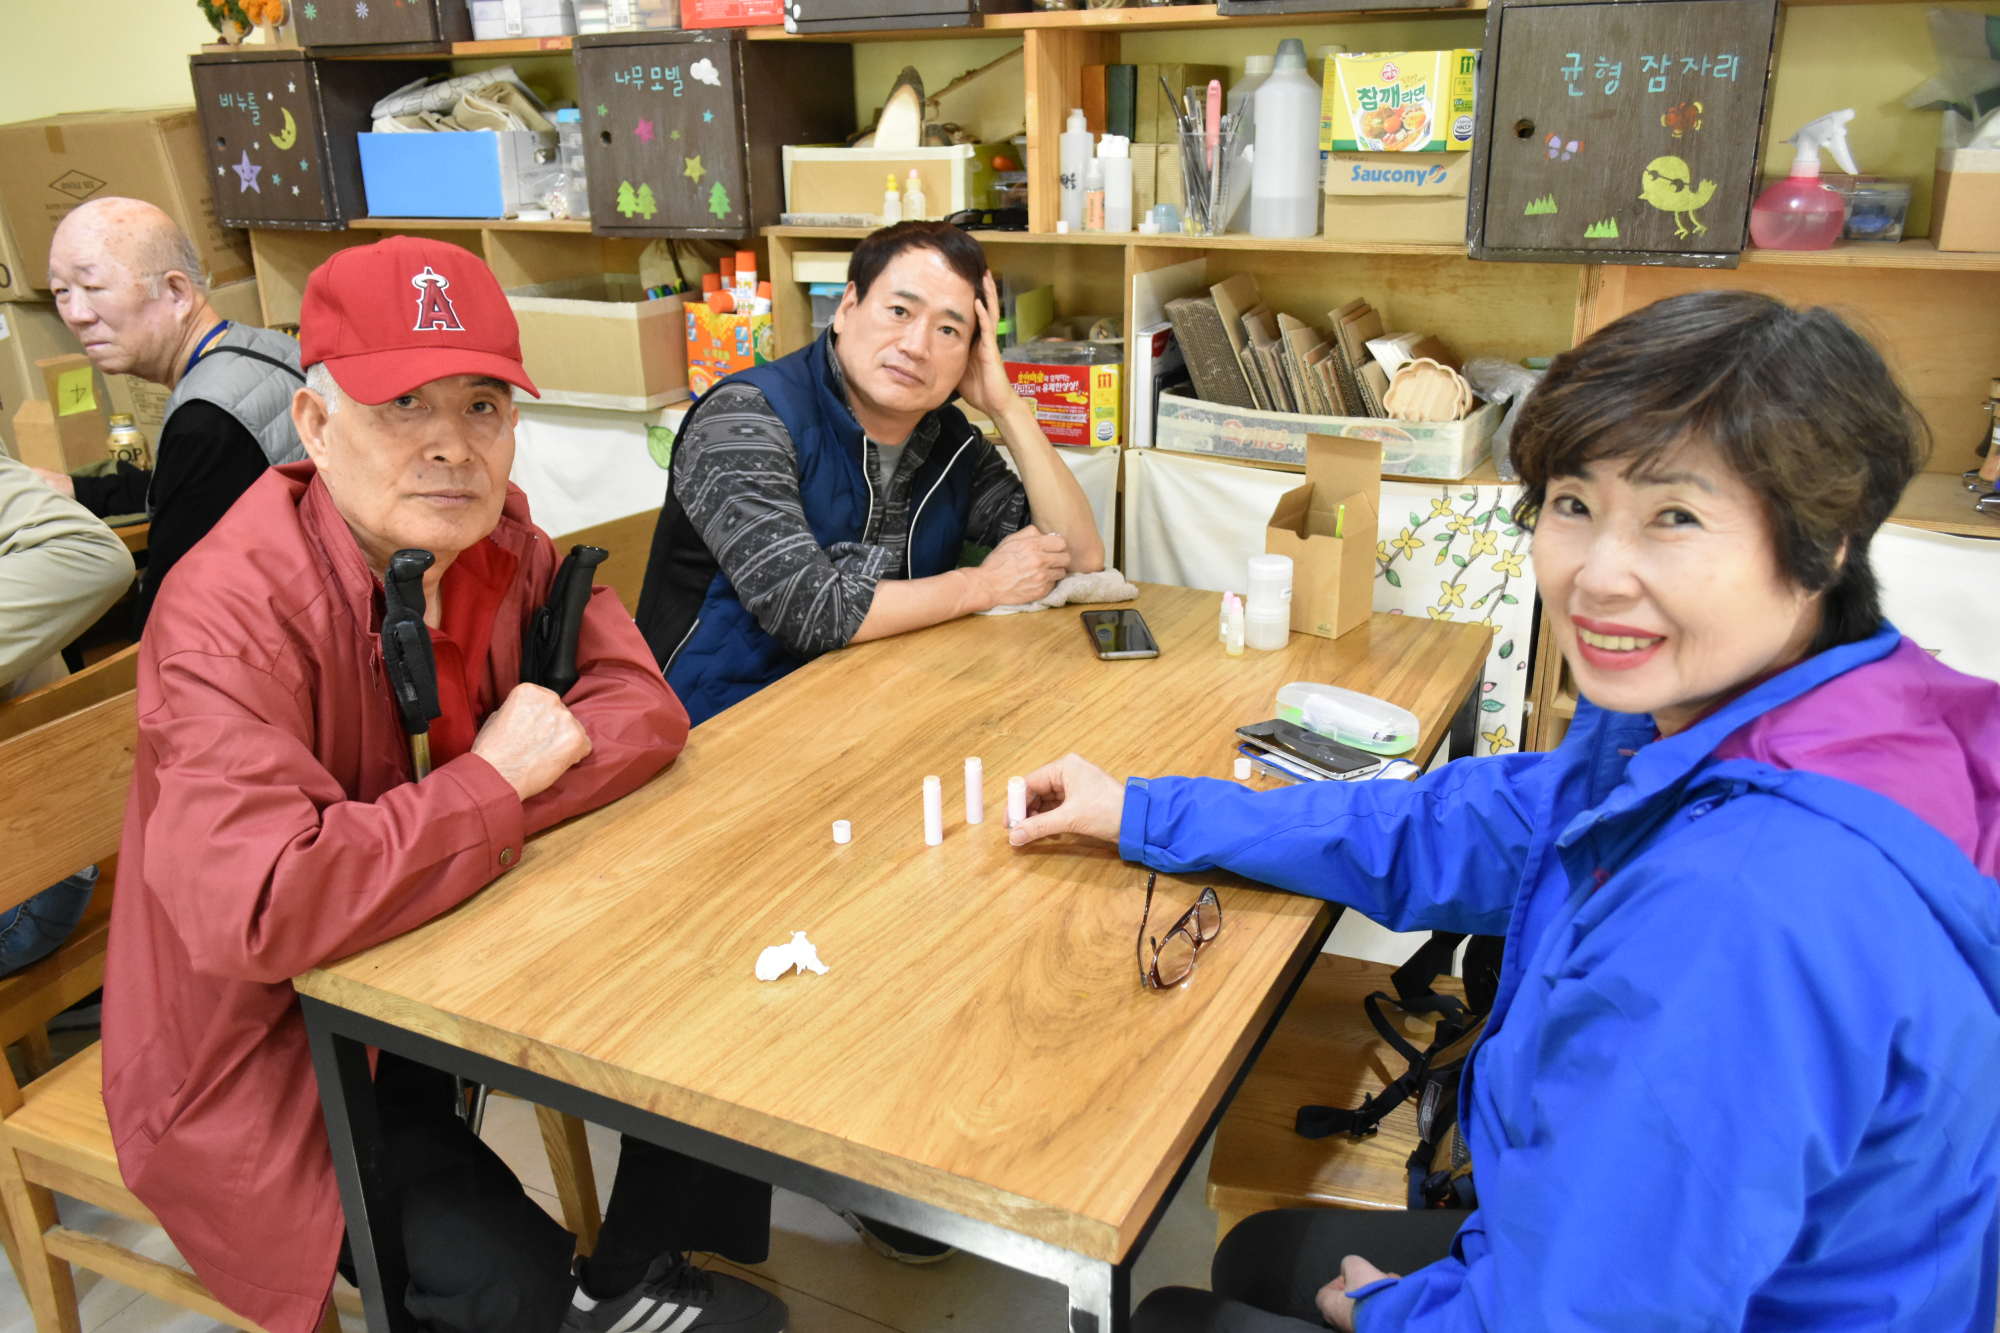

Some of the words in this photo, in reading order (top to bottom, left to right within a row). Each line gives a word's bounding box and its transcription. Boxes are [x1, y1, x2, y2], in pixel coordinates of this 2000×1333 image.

[615, 65, 645, 91] 나무
[650, 65, 684, 97] 모빌
[1560, 53, 1622, 97] 균형
[1640, 54, 1739, 94] 잠자리
[219, 92, 261, 127] 비누틀
[1357, 83, 1426, 112] 참깨라면
[1350, 164, 1428, 187] Saucony
[412, 266, 466, 331] A
